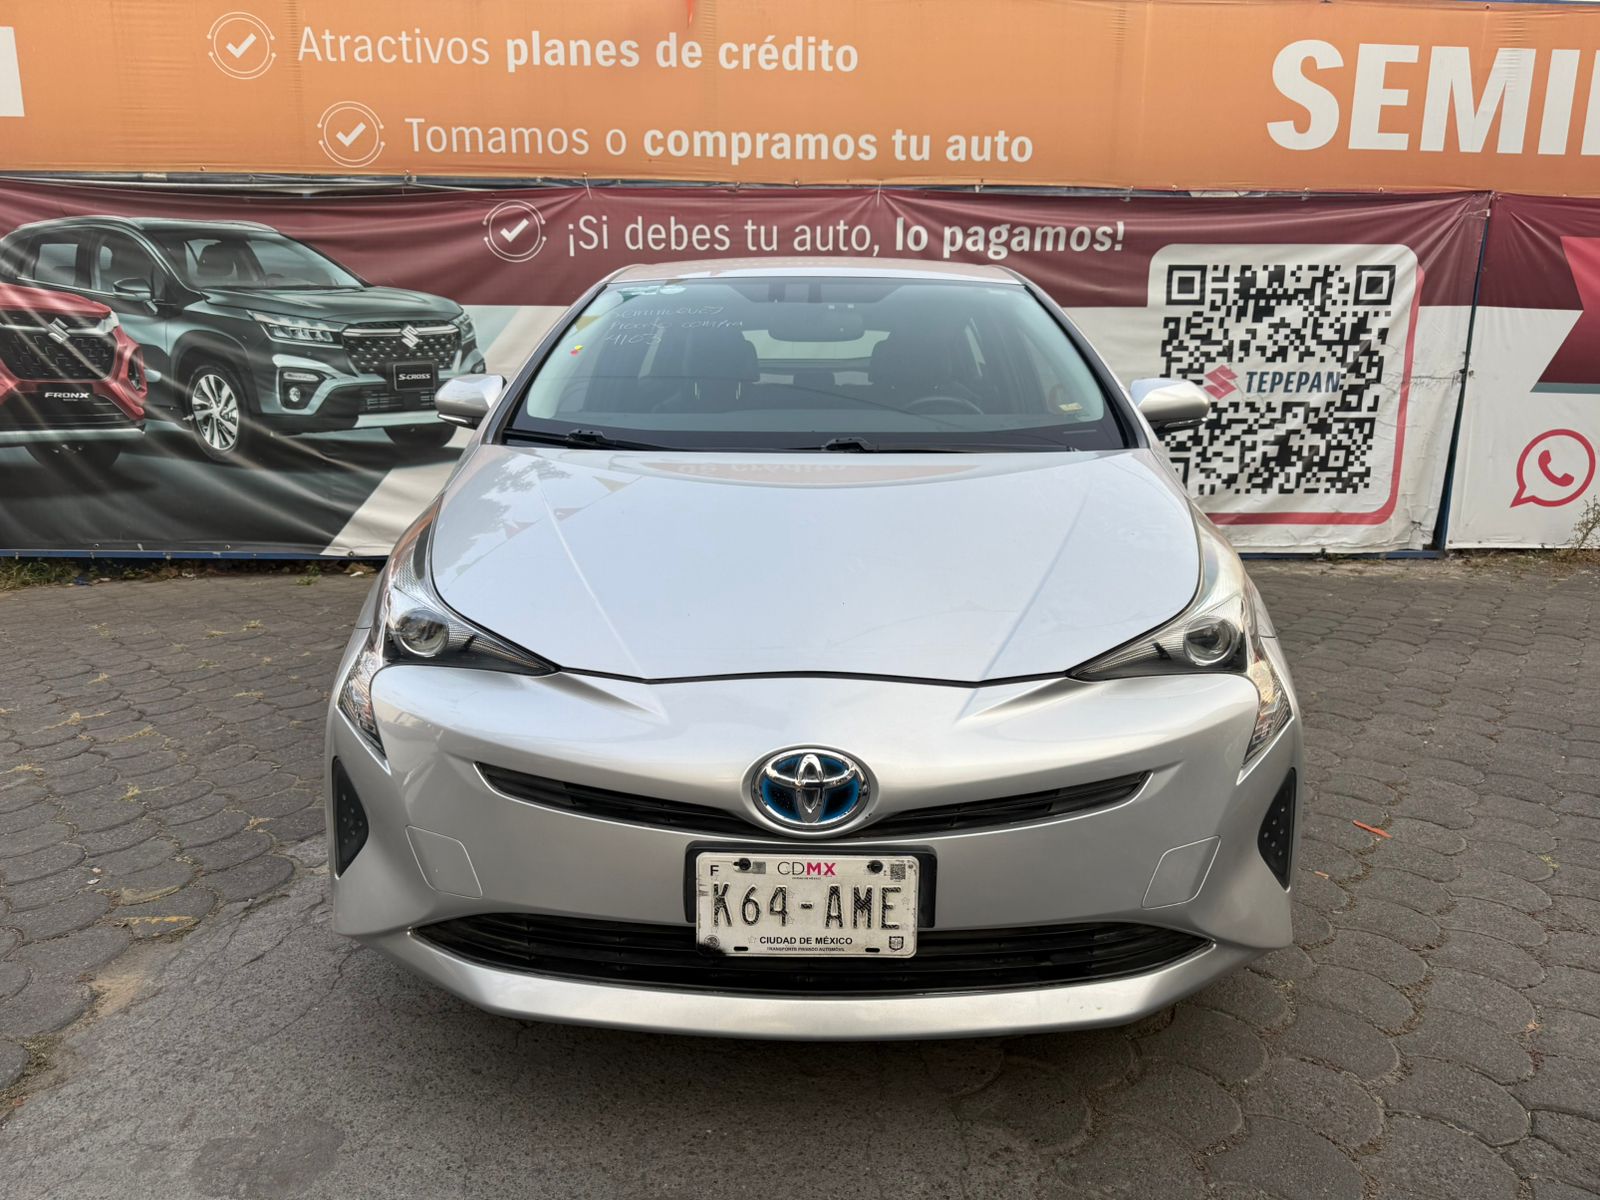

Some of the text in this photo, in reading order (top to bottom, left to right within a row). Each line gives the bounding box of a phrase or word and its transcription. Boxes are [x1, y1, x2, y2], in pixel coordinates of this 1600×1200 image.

[299, 26, 858, 73] Atractivos planes de crédito
[405, 117, 1032, 165] Tomamos o compramos tu auto
[567, 214, 1125, 260] ¡Si debes tu auto, lo pagamos!
[1245, 370, 1340, 394] TEPEPAN
[44, 391, 90, 399] FRONX
[710, 864, 720, 876] F
[777, 861, 837, 876] CDMX
[759, 935, 853, 945] CIUDAD DE MÉXICO
